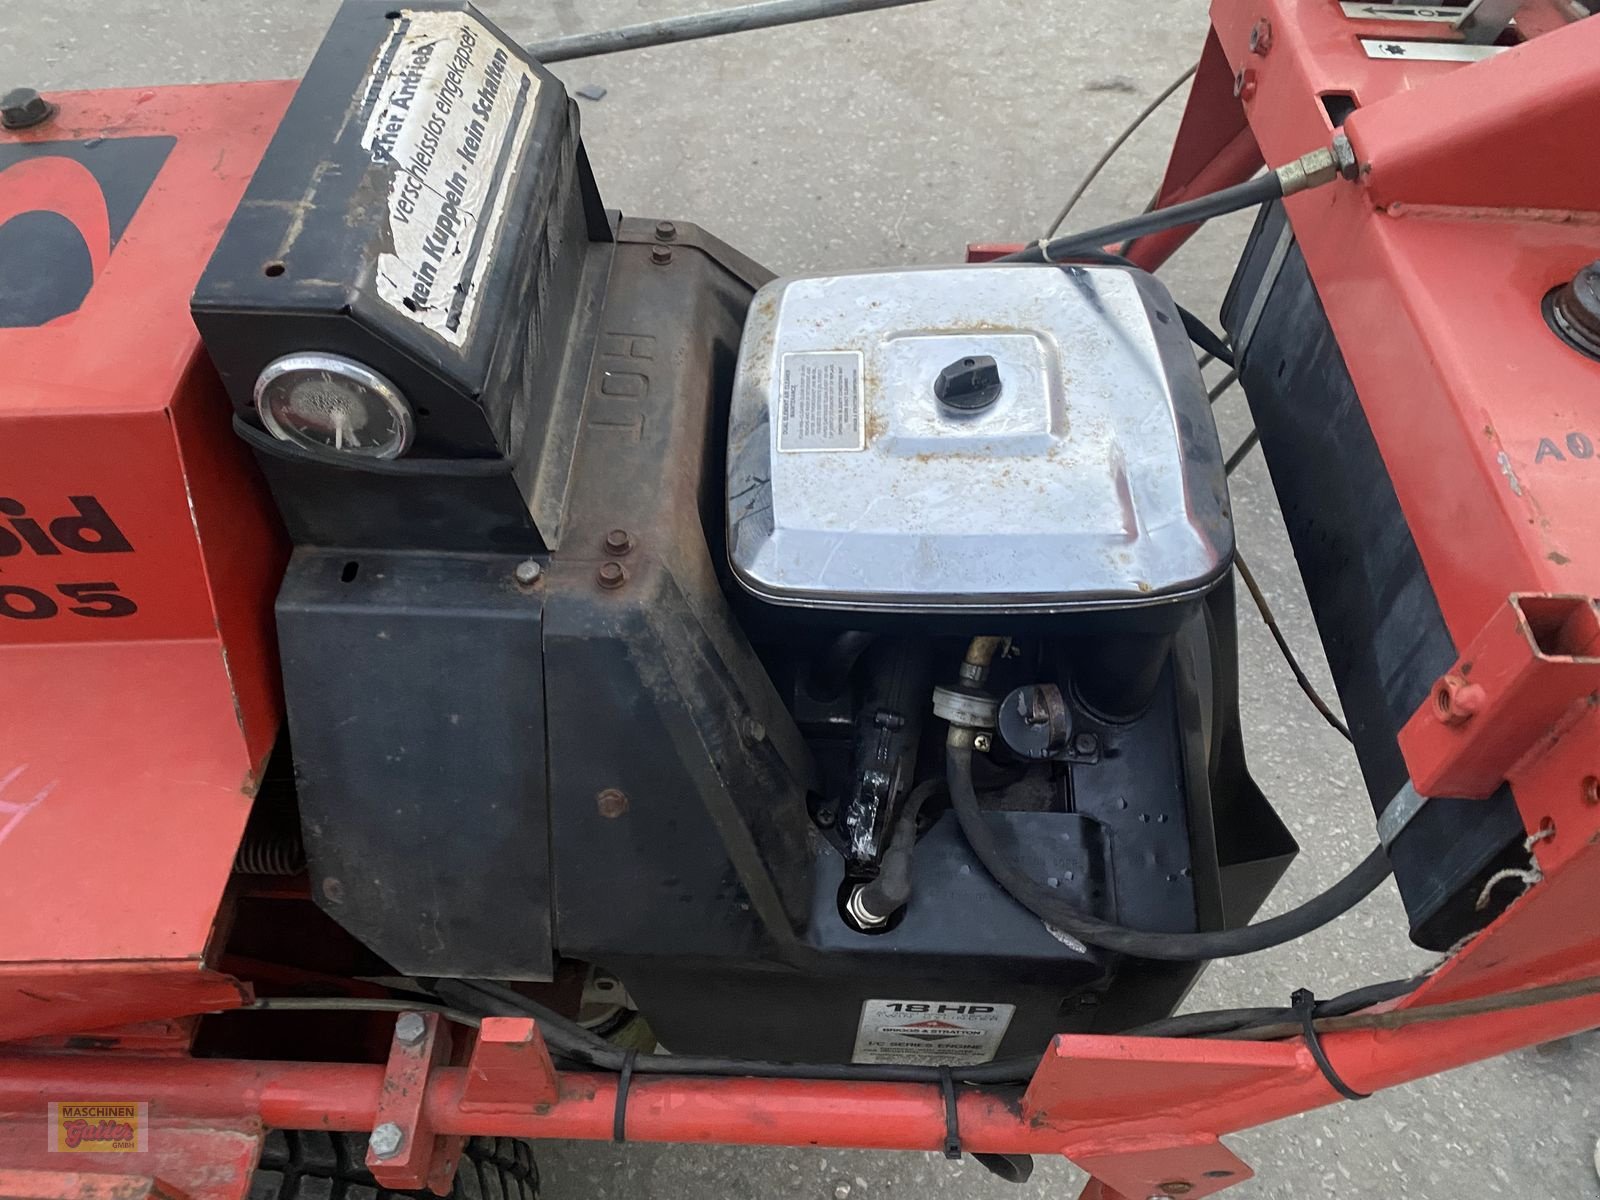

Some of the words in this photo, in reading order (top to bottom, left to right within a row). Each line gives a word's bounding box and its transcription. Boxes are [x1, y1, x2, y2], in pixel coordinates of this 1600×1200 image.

[393, 113, 447, 225] verschleisslos
[422, 172, 469, 263] Kuppeln
[456, 118, 486, 166] kein
[472, 48, 509, 122] Schalten
[886, 1003, 930, 1013] 18
[937, 1004, 994, 1015] HP
[937, 1042, 983, 1050] ENGINE
